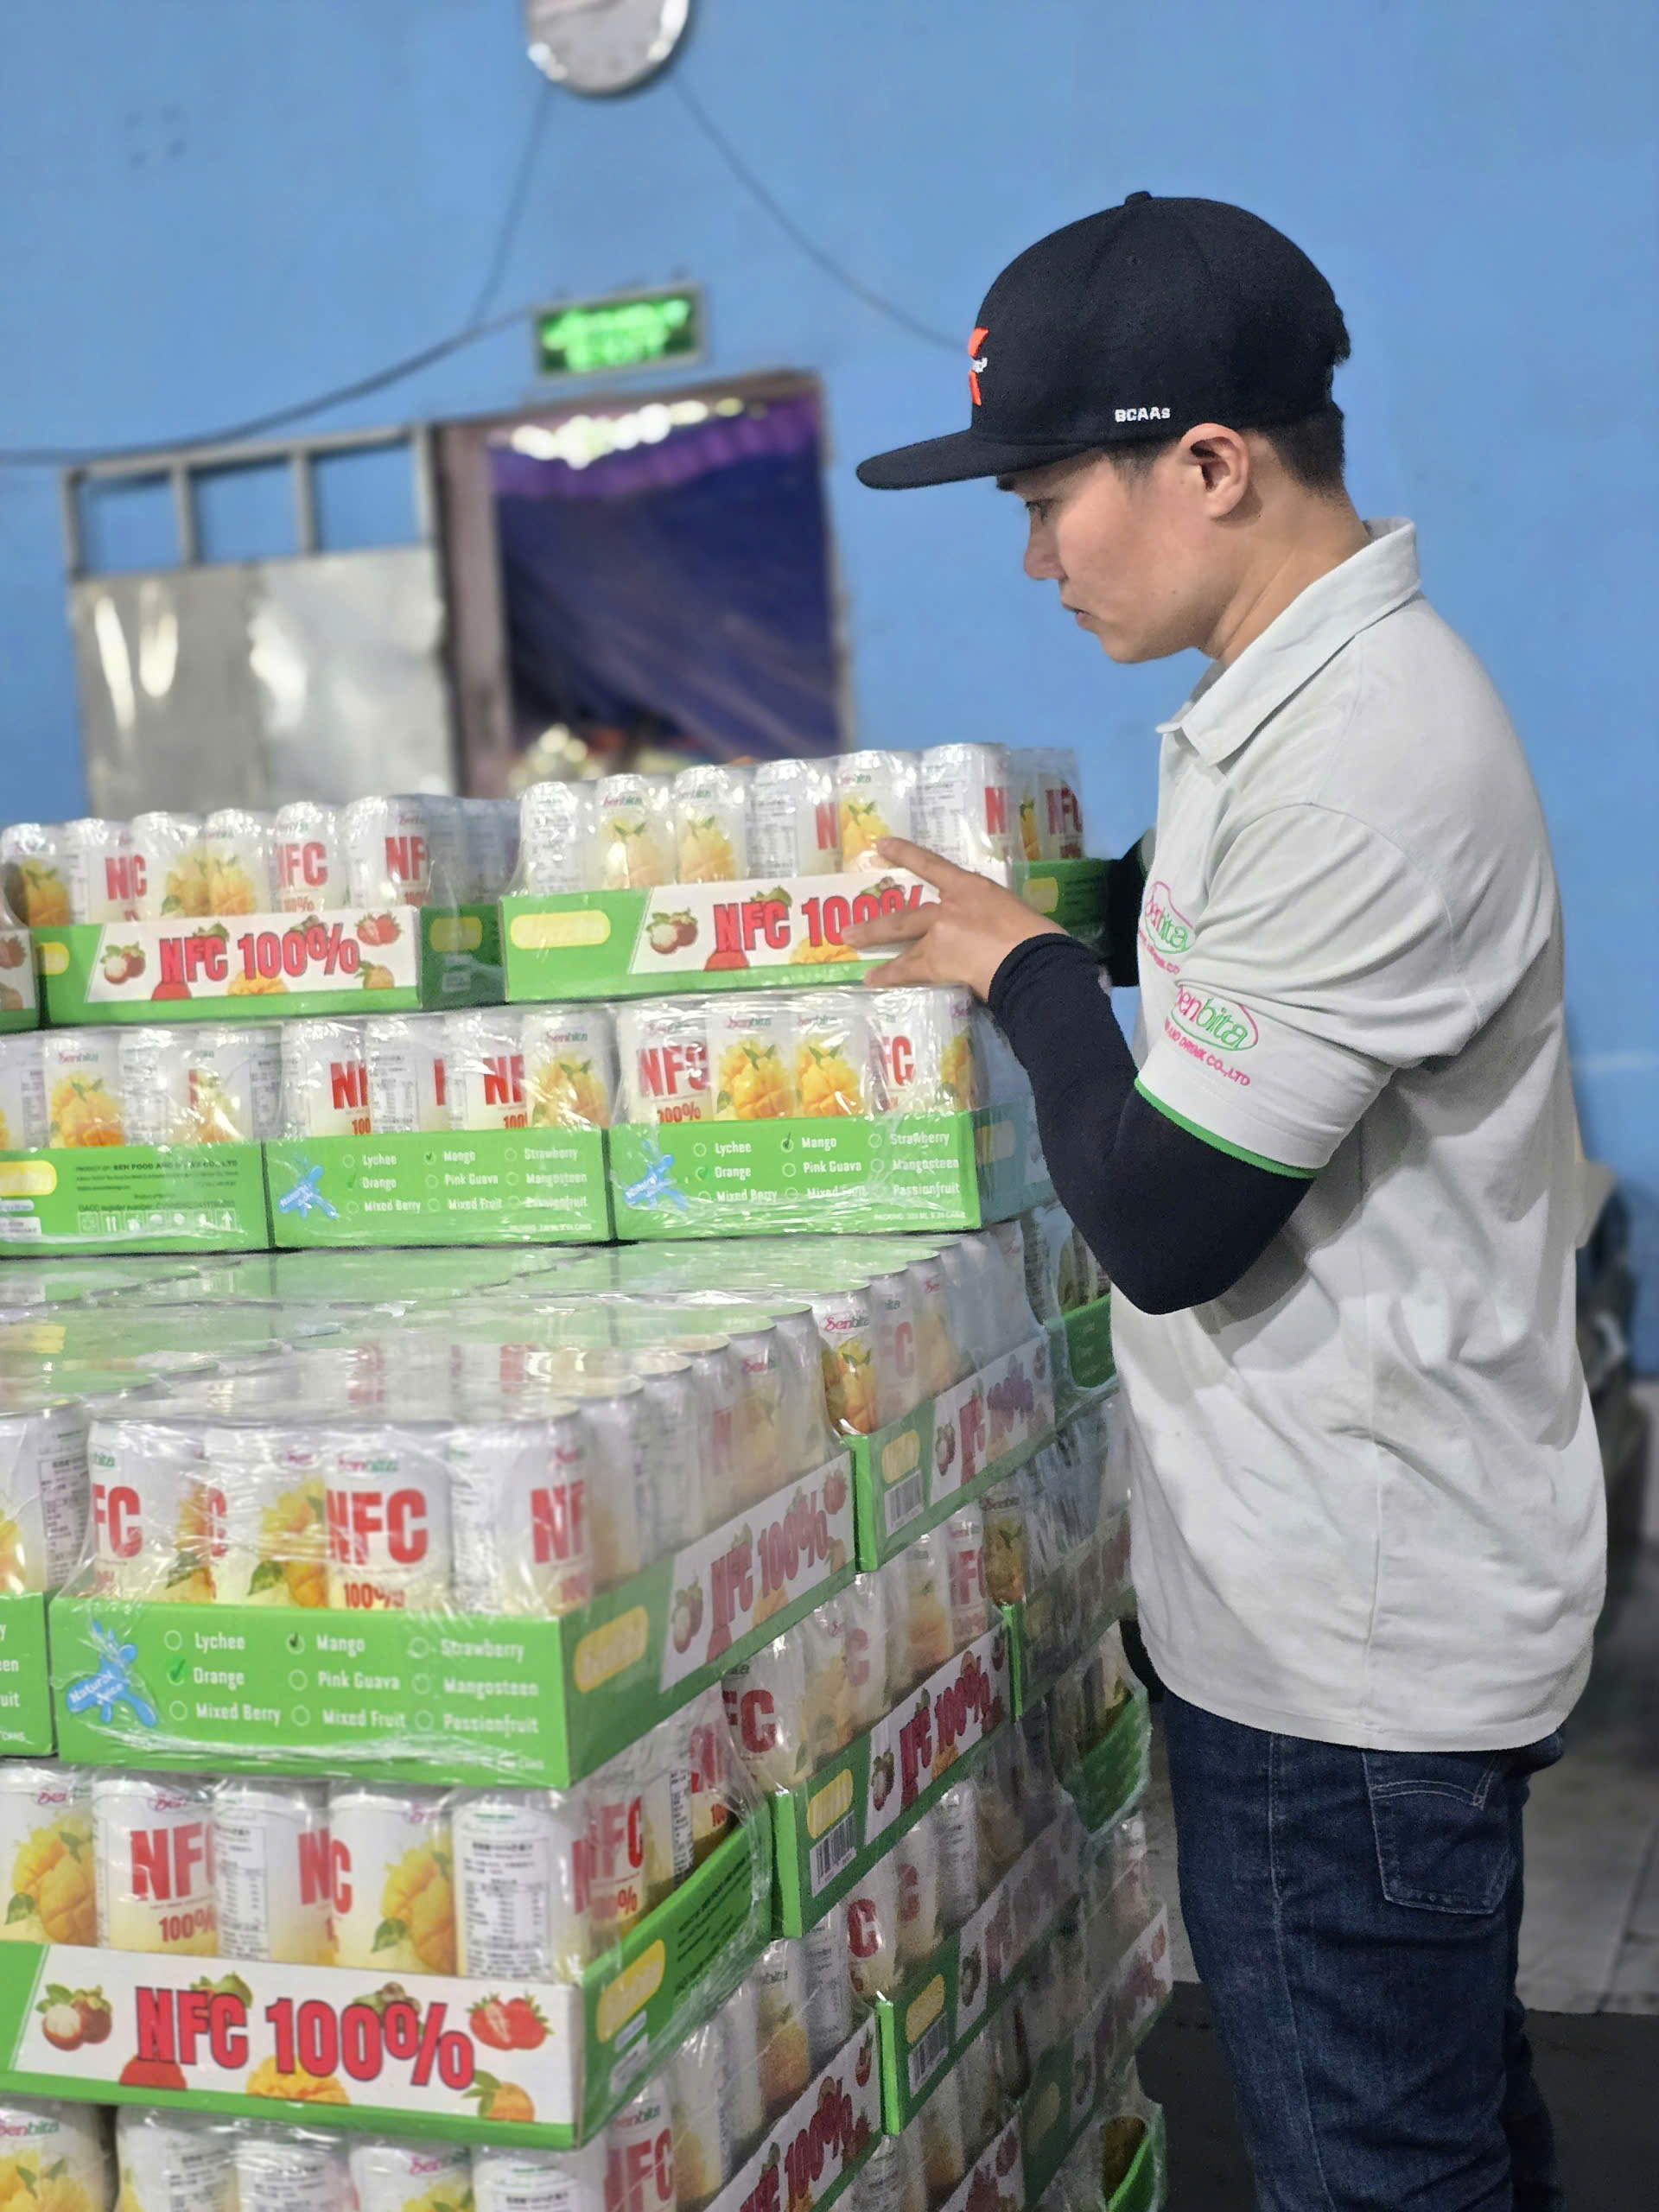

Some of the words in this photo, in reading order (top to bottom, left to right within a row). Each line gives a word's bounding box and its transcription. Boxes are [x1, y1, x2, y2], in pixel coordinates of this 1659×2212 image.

[1115, 406, 1171, 423] BCAAs
[385, 836, 427, 881] NF
[713, 898, 791, 950] NFC
[159, 935, 228, 982] NFC
[238, 923, 361, 979] 100%
[1176, 985, 1249, 1049] enbita
[715, 1141, 752, 1157] Lychee
[802, 1136, 836, 1151] Mango
[363, 1154, 397, 1168] Lychee
[443, 1150, 475, 1164] Mango
[804, 1160, 826, 1173] Pink
[829, 1160, 861, 1173] Guava
[892, 1158, 959, 1173] Mangosteen
[445, 1173, 466, 1185] Pink
[468, 1173, 499, 1185] Guava
[526, 1173, 588, 1187] Mangosteen
[715, 1166, 752, 1180] Orange
[362, 1177, 397, 1192] Orange
[365, 1200, 393, 1211] Mixed
[396, 1199, 422, 1214] Berry
[448, 1198, 477, 1211] Mixed
[480, 1198, 502, 1210] Fruit
[716, 1189, 747, 1202] Mixed
[751, 1189, 778, 1204] Berry
[326, 1488, 429, 1566] NFC
[195, 1631, 245, 1654] Lychee
[316, 1634, 365, 1658] Mango
[441, 1638, 524, 1664] Strawberry
[194, 1667, 245, 1691] Orange
[318, 1670, 350, 1688] Pink
[353, 1671, 401, 1691] Guava
[443, 1677, 539, 1700] Mangosteen
[195, 1702, 238, 1720] Mixed
[242, 1703, 281, 1726] Berry
[322, 1709, 367, 1727] Mixed
[371, 1710, 406, 1729] Fruit
[442, 1713, 540, 1738] Passionfruit
[130, 1822, 214, 1901] NF
[135, 1986, 250, 2069] NFC
[265, 1998, 475, 2090] 100%
